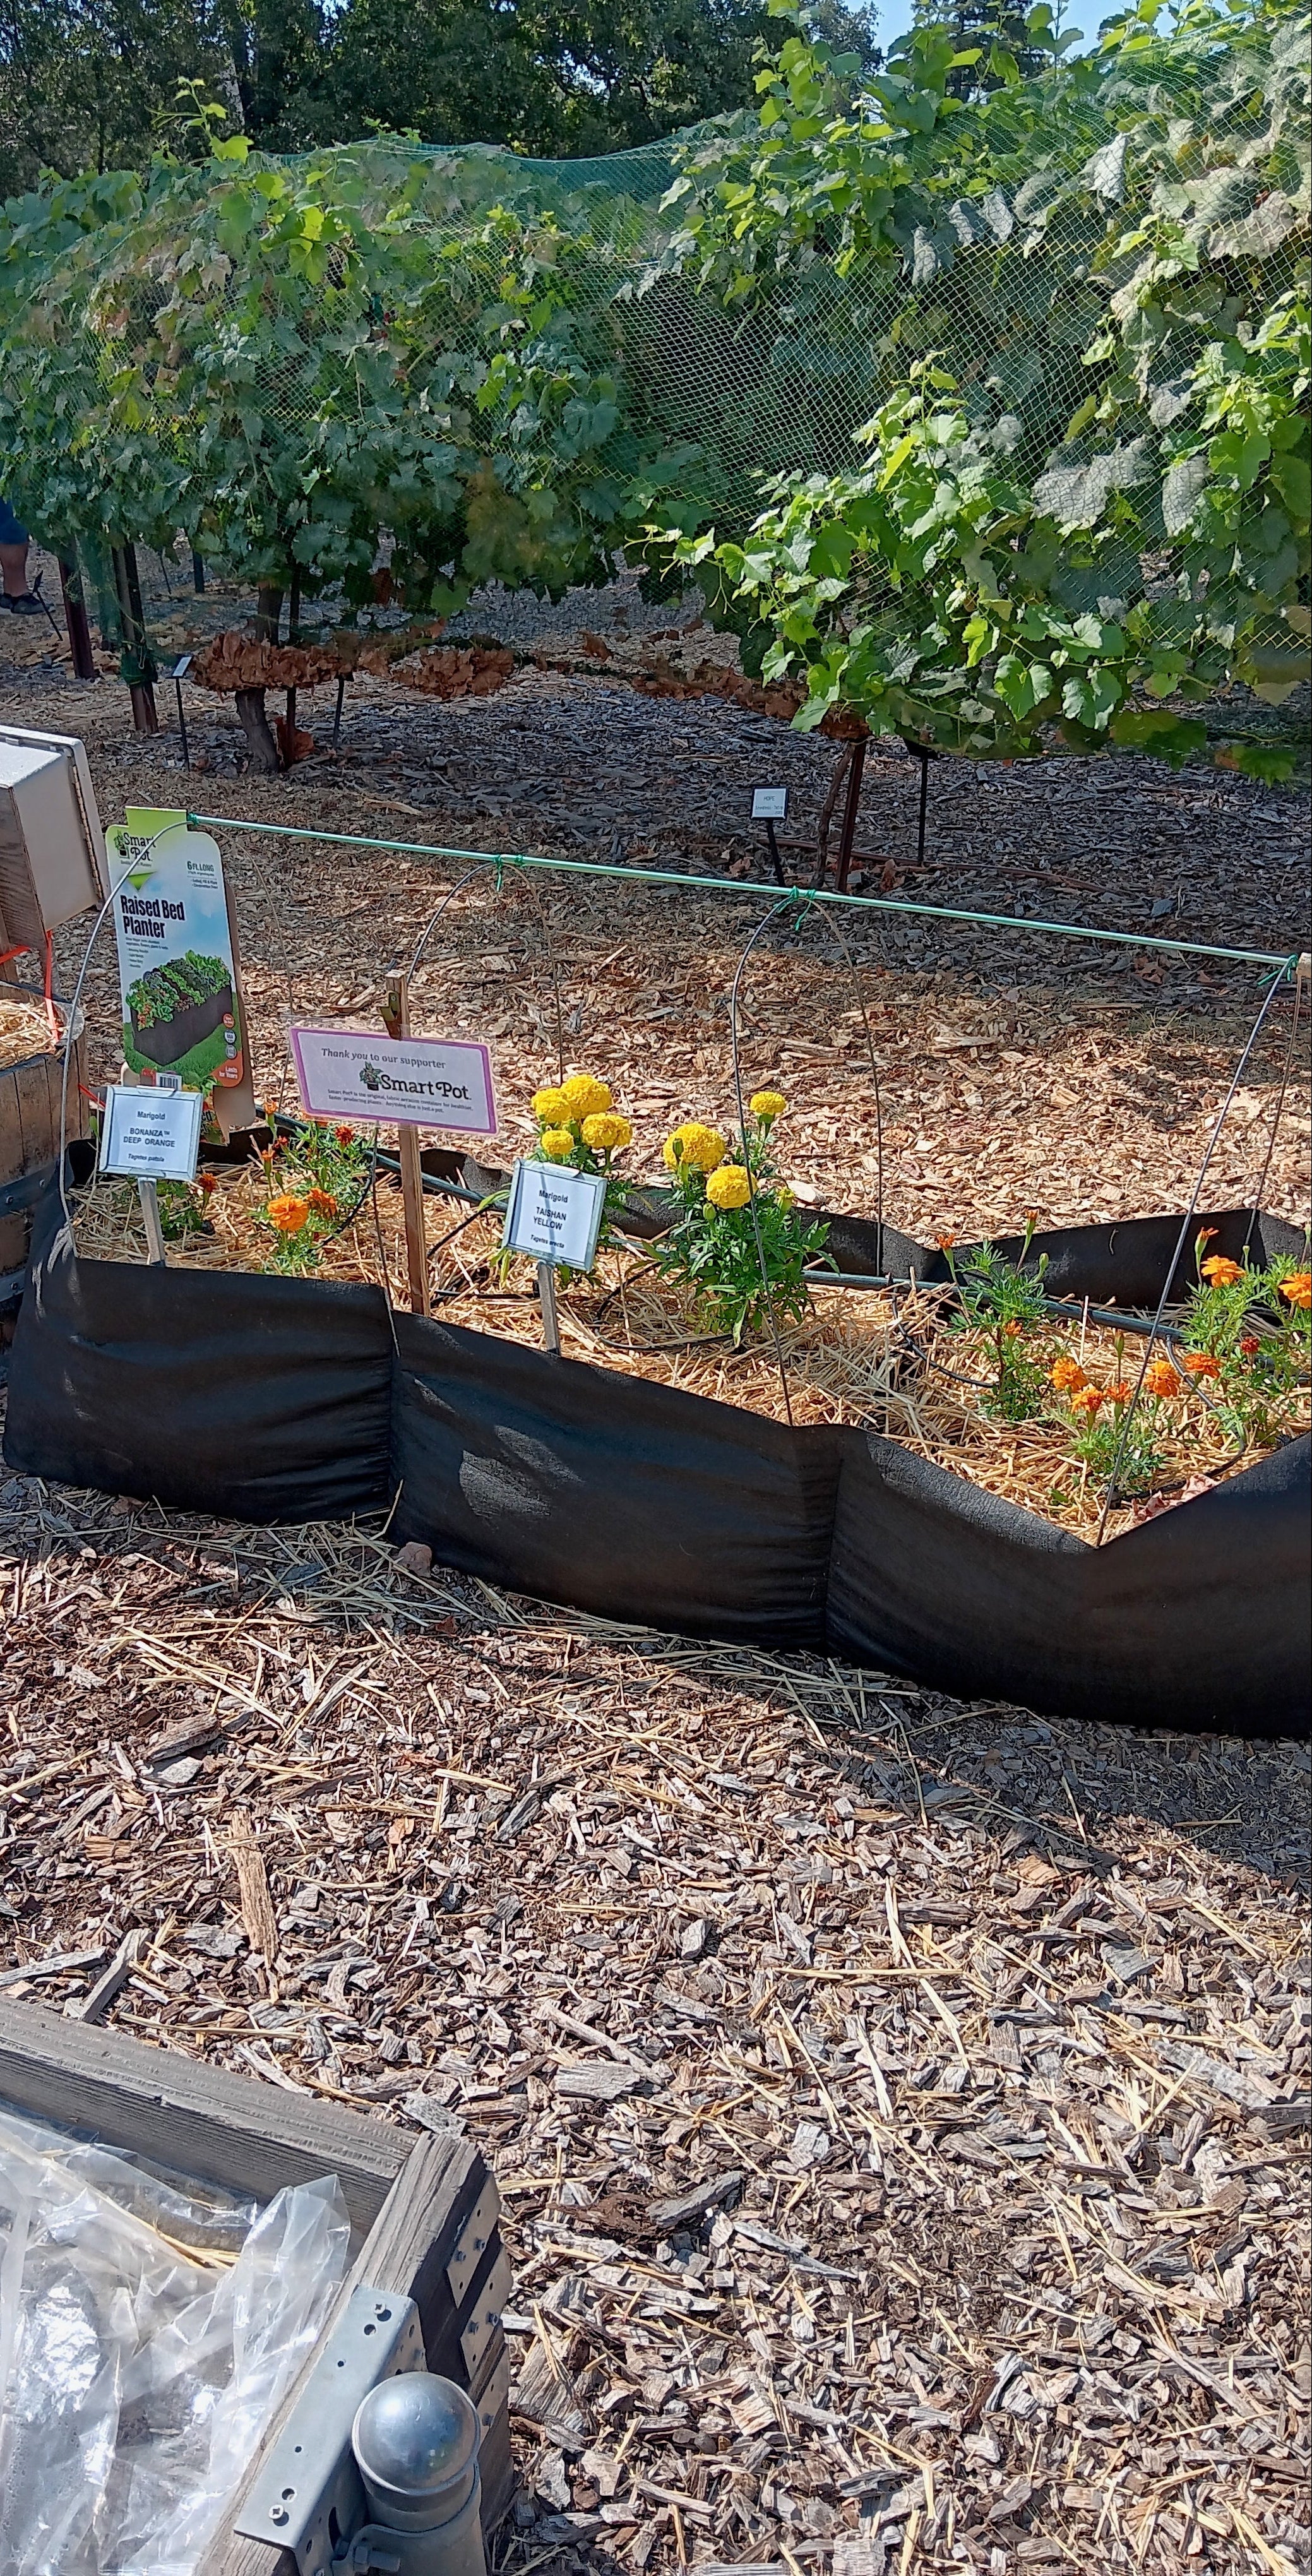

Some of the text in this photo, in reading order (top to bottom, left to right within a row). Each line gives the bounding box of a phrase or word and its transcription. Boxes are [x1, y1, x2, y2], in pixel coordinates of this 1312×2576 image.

[187, 861, 192, 870] 6
[120, 895, 185, 921] Raised Bed
[123, 915, 165, 938] Planter
[321, 1047, 350, 1058] Thank
[400, 1058, 446, 1068] supporter
[380, 1075, 434, 1095] Smart
[137, 1111, 165, 1121] Marigold
[123, 1136, 176, 1147] DEEP ORANGE
[539, 1190, 568, 1203] Marigold
[537, 1207, 567, 1221] TAISHAN
[533, 1216, 562, 1230] YELLOW
[530, 1234, 564, 1248] Tagetes erecta
